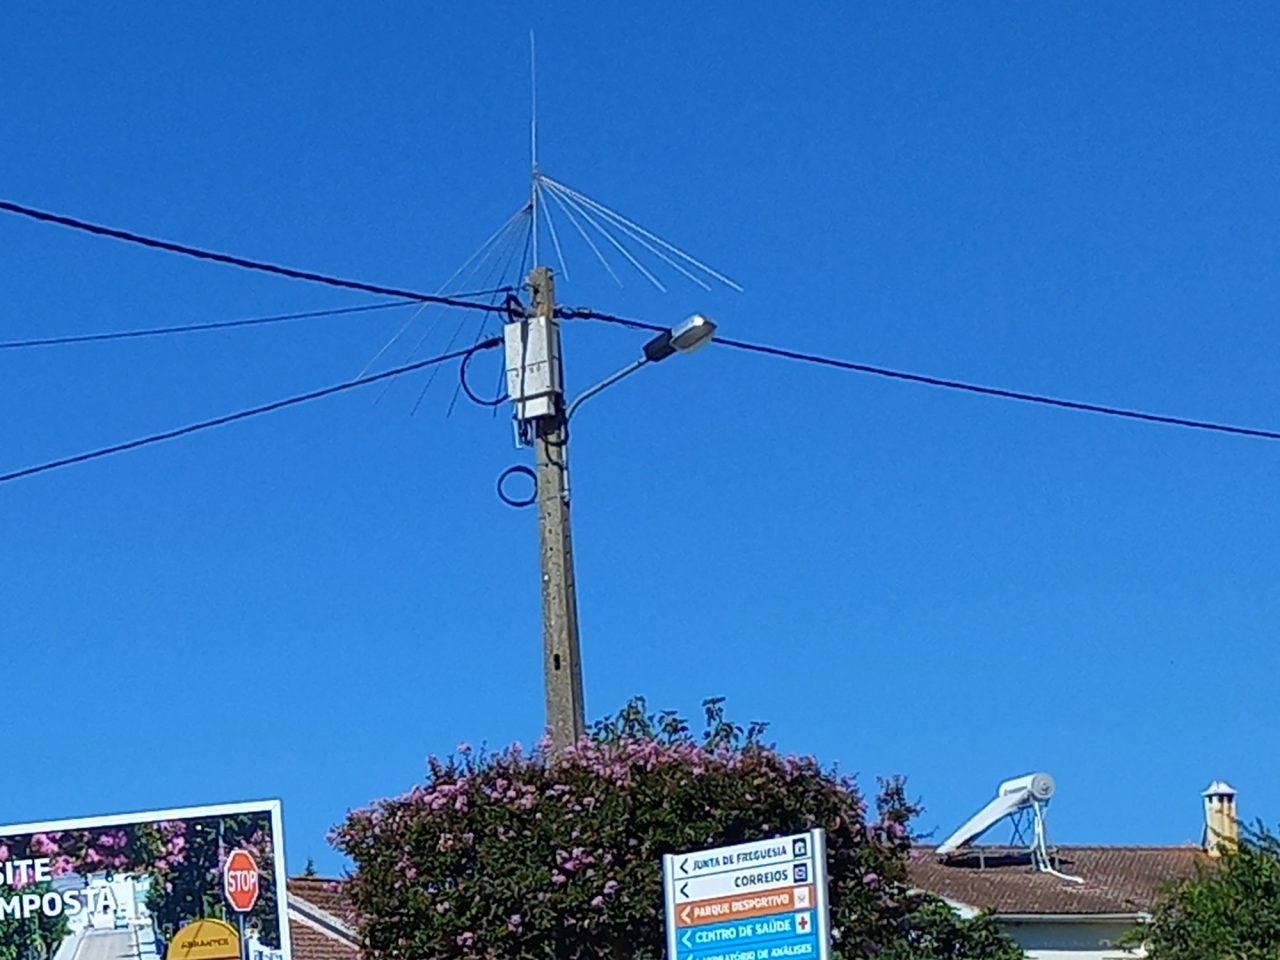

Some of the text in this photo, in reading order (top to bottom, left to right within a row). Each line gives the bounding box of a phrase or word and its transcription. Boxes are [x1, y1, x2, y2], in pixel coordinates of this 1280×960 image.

[693, 845, 788, 871] JUNTA DE FREGUESIA
[228, 870, 257, 893] STOP
[734, 870, 788, 888] CORREIOS
[693, 894, 790, 919] PARQUE DESPORTIVO
[695, 919, 791, 943] CENTRO DE SAÚDE
[757, 948, 769, 959] DE
